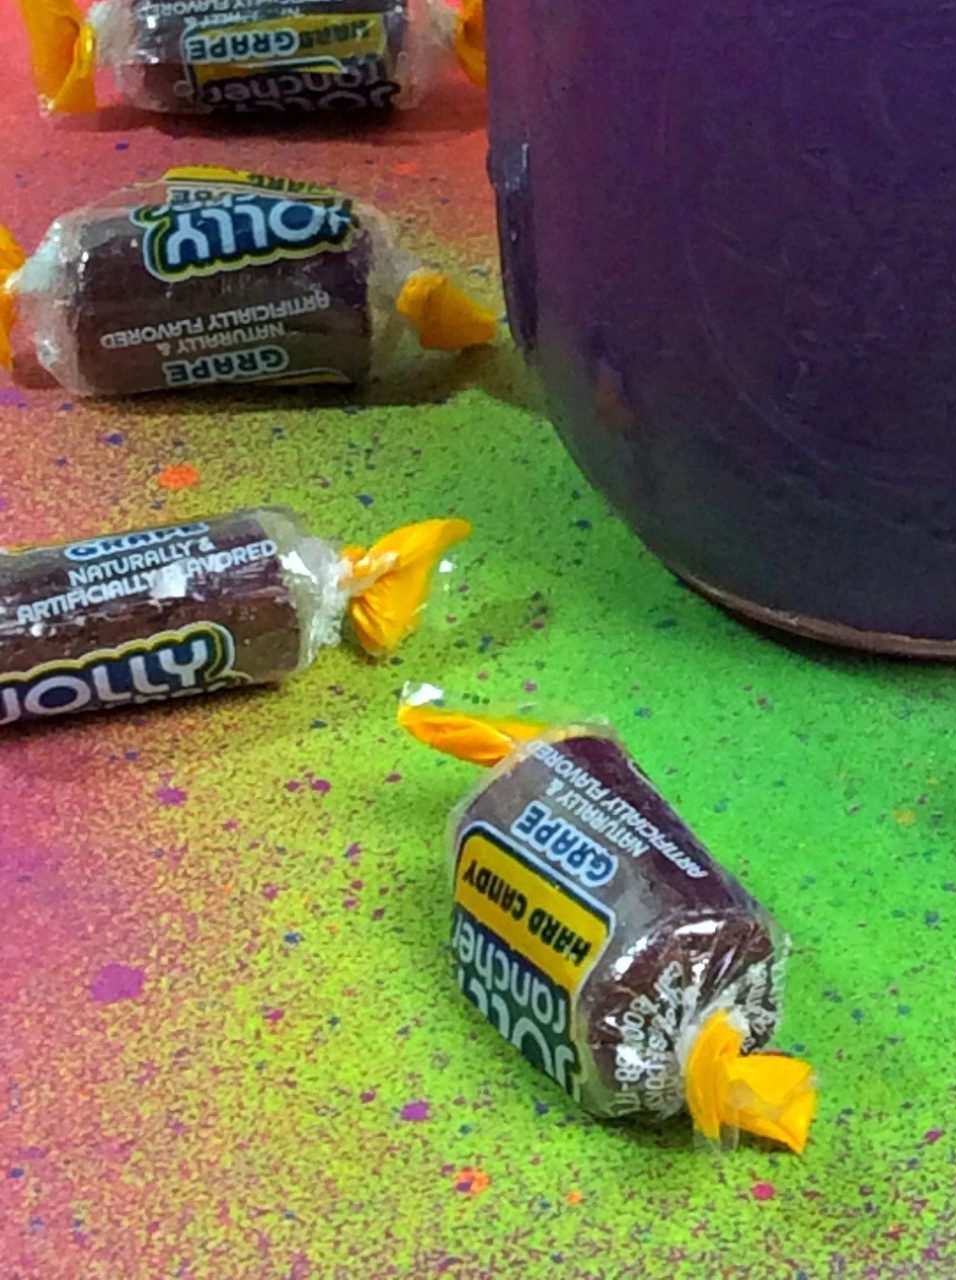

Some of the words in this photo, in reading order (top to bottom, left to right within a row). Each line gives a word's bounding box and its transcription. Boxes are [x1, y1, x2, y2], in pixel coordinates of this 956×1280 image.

[188, 30, 298, 61] GRAPE
[101, 314, 203, 349] FLAVORED
[177, 321, 286, 356] NATURALLY
[207, 291, 331, 334] ARTIFICIALLY
[170, 347, 285, 384] GRAPE
[16, 572, 154, 625] ARTIFICIALLY
[157, 539, 278, 582] AVORED
[68, 539, 191, 587] NATURALLY
[198, 535, 216, 553] &
[0, 639, 210, 726] JOLLY
[512, 803, 615, 885] GRAPE
[556, 789, 650, 859] NATURALLY
[600, 794, 709, 879] ARTIFICIALLY
[462, 858, 528, 921] CANDY
[527, 908, 592, 967] HARD
[458, 968, 575, 1090] JOLL
